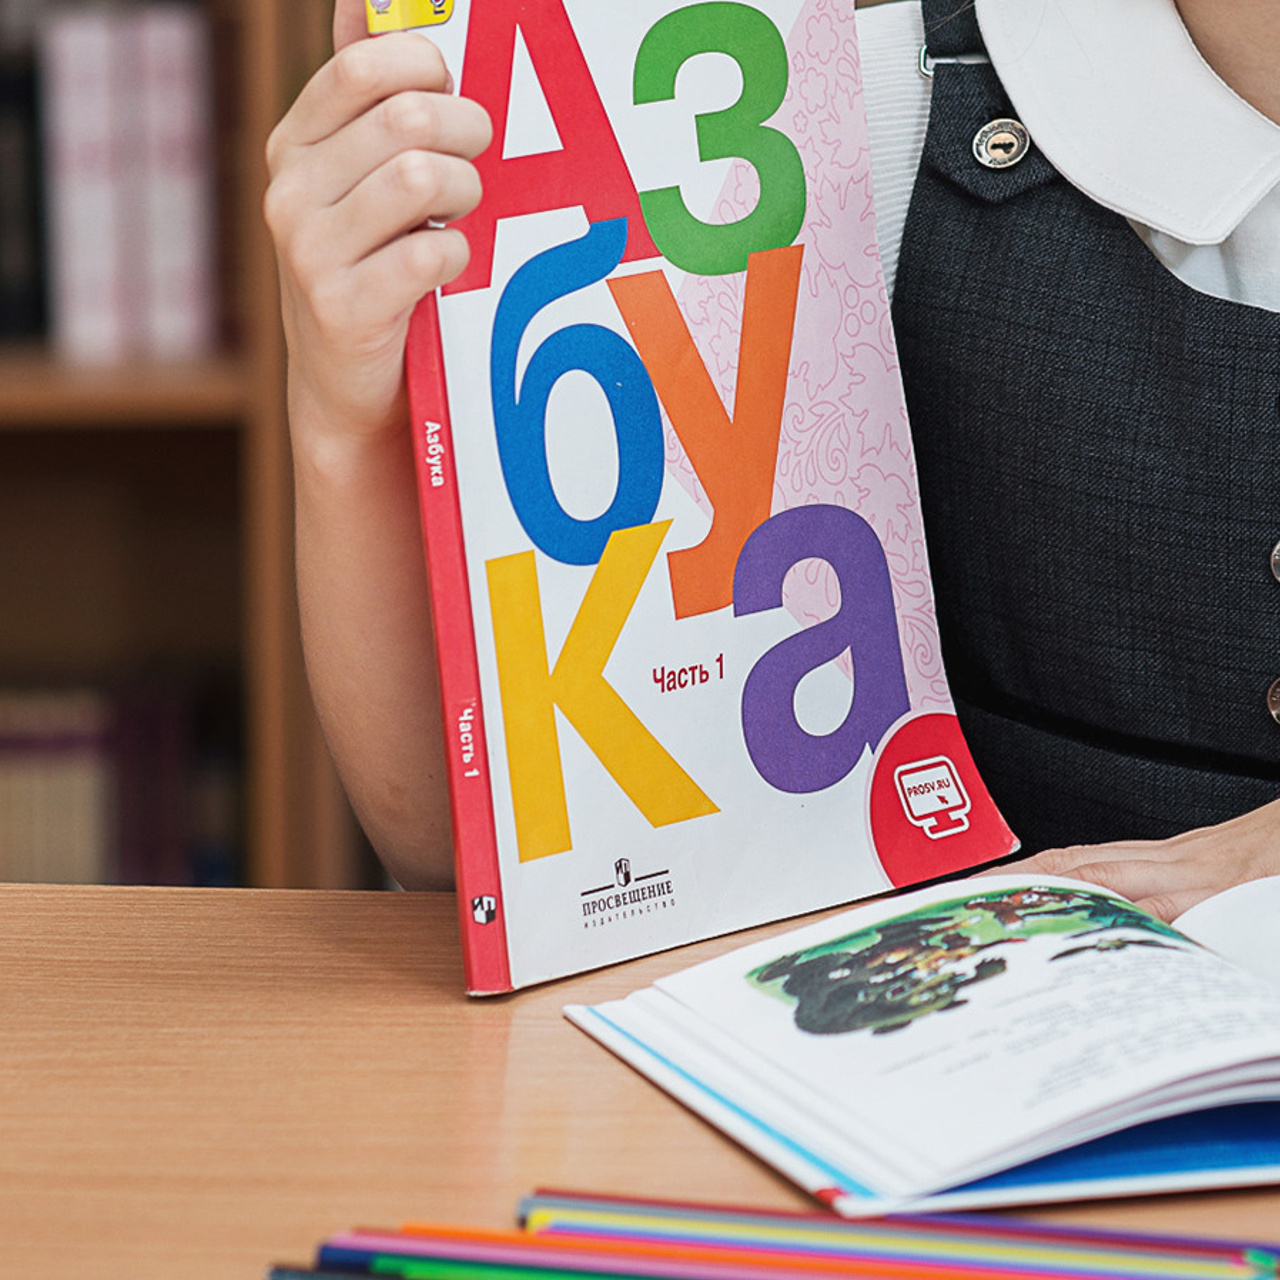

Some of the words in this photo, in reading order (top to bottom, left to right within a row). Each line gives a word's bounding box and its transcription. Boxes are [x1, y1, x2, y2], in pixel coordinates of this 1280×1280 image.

[424, 420, 445, 487] Азбука
[652, 664, 710, 693] Часть
[715, 652, 724, 679] 1
[458, 707, 475, 764] Часть
[464, 767, 480, 778] 1
[906, 777, 952, 798] PROSV.RU
[581, 879, 674, 917] ПРОСВЕЩЕНИЕ
